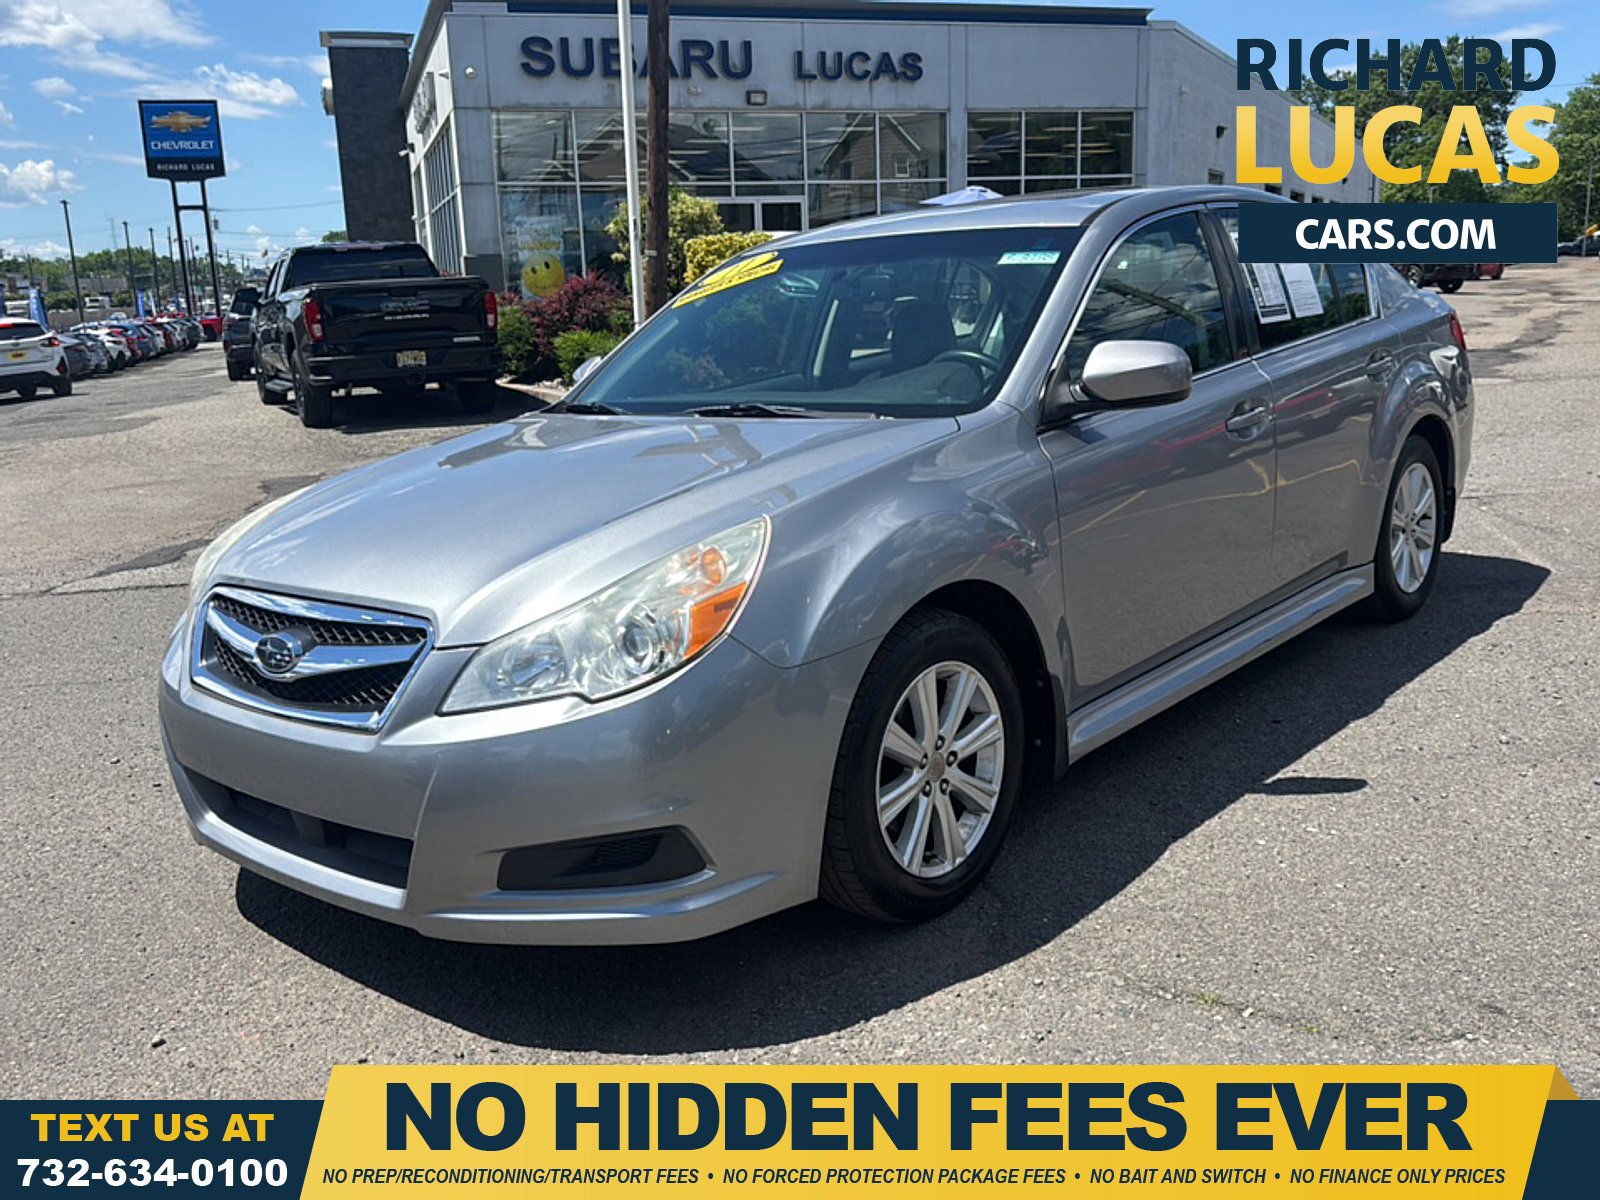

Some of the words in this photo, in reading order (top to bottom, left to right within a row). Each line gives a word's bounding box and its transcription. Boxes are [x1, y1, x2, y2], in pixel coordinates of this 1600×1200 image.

[794, 50, 924, 82] LUCAS
[151, 140, 214, 150] CHEVROLET
[156, 163, 188, 171] RICHARD
[192, 163, 215, 171] LUCAS
